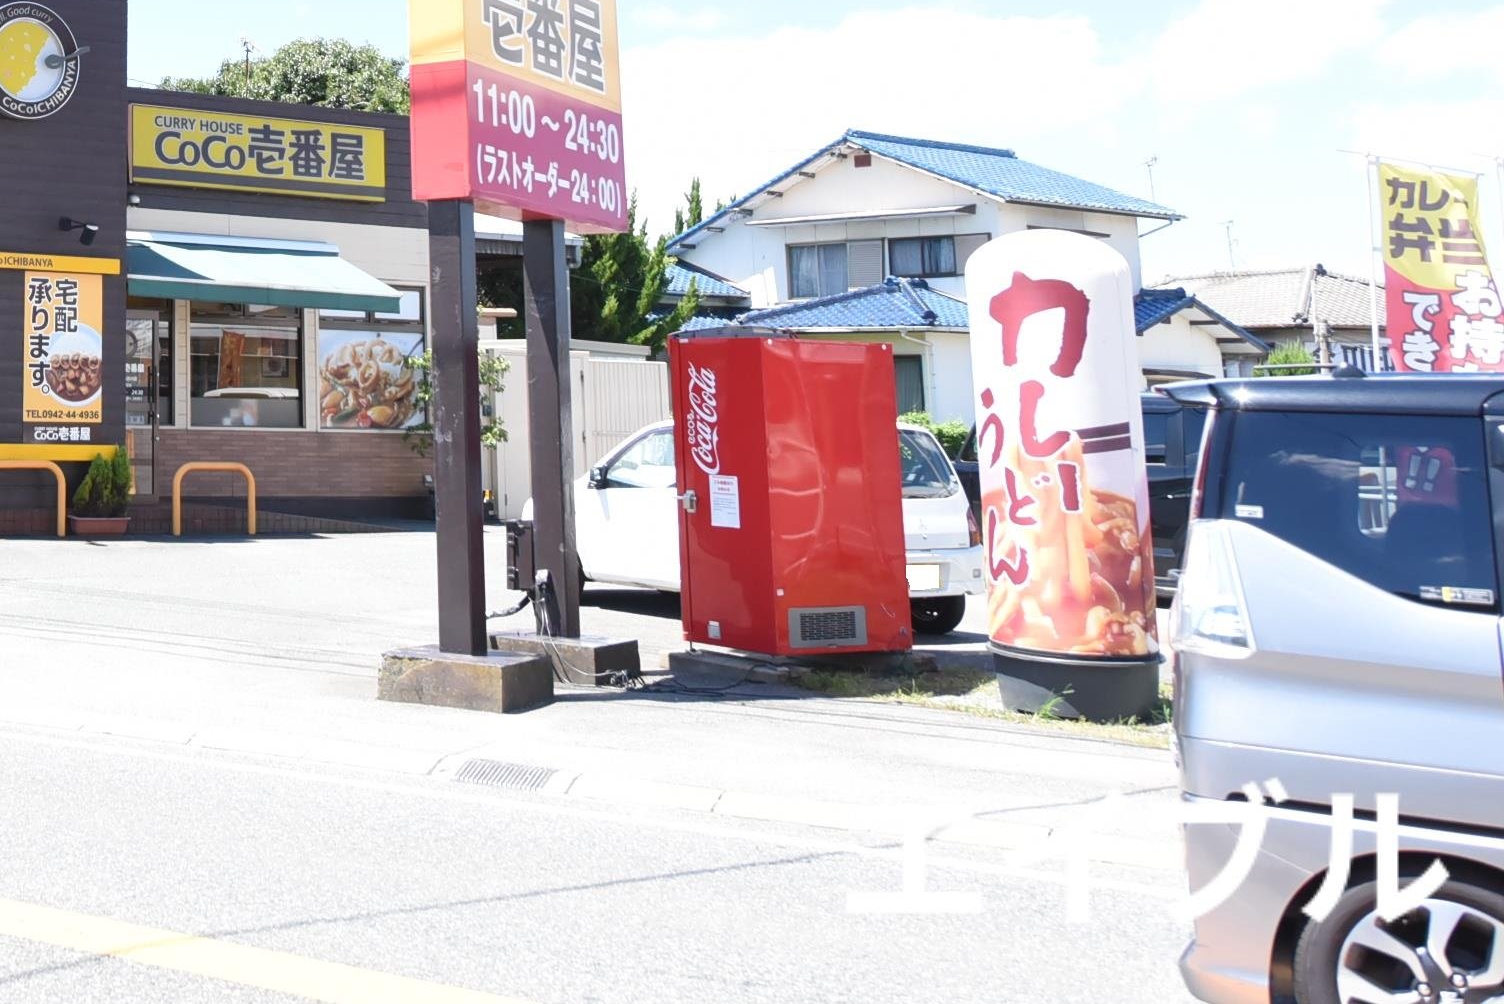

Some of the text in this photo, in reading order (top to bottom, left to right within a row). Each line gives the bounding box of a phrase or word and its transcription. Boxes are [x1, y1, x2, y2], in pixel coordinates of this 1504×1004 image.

[7, 5, 31, 18] Good
[31, 8, 54, 24] curry
[154, 115, 244, 136] CURRY HOUSE
[28, 276, 52, 395] 承ります。
[54, 277, 78, 333] 宅配
[1447, 269, 1504, 372] お持
[687, 360, 720, 476] Coca-Cola
[989, 271, 1091, 512] カレー
[978, 387, 1050, 586] うどん
